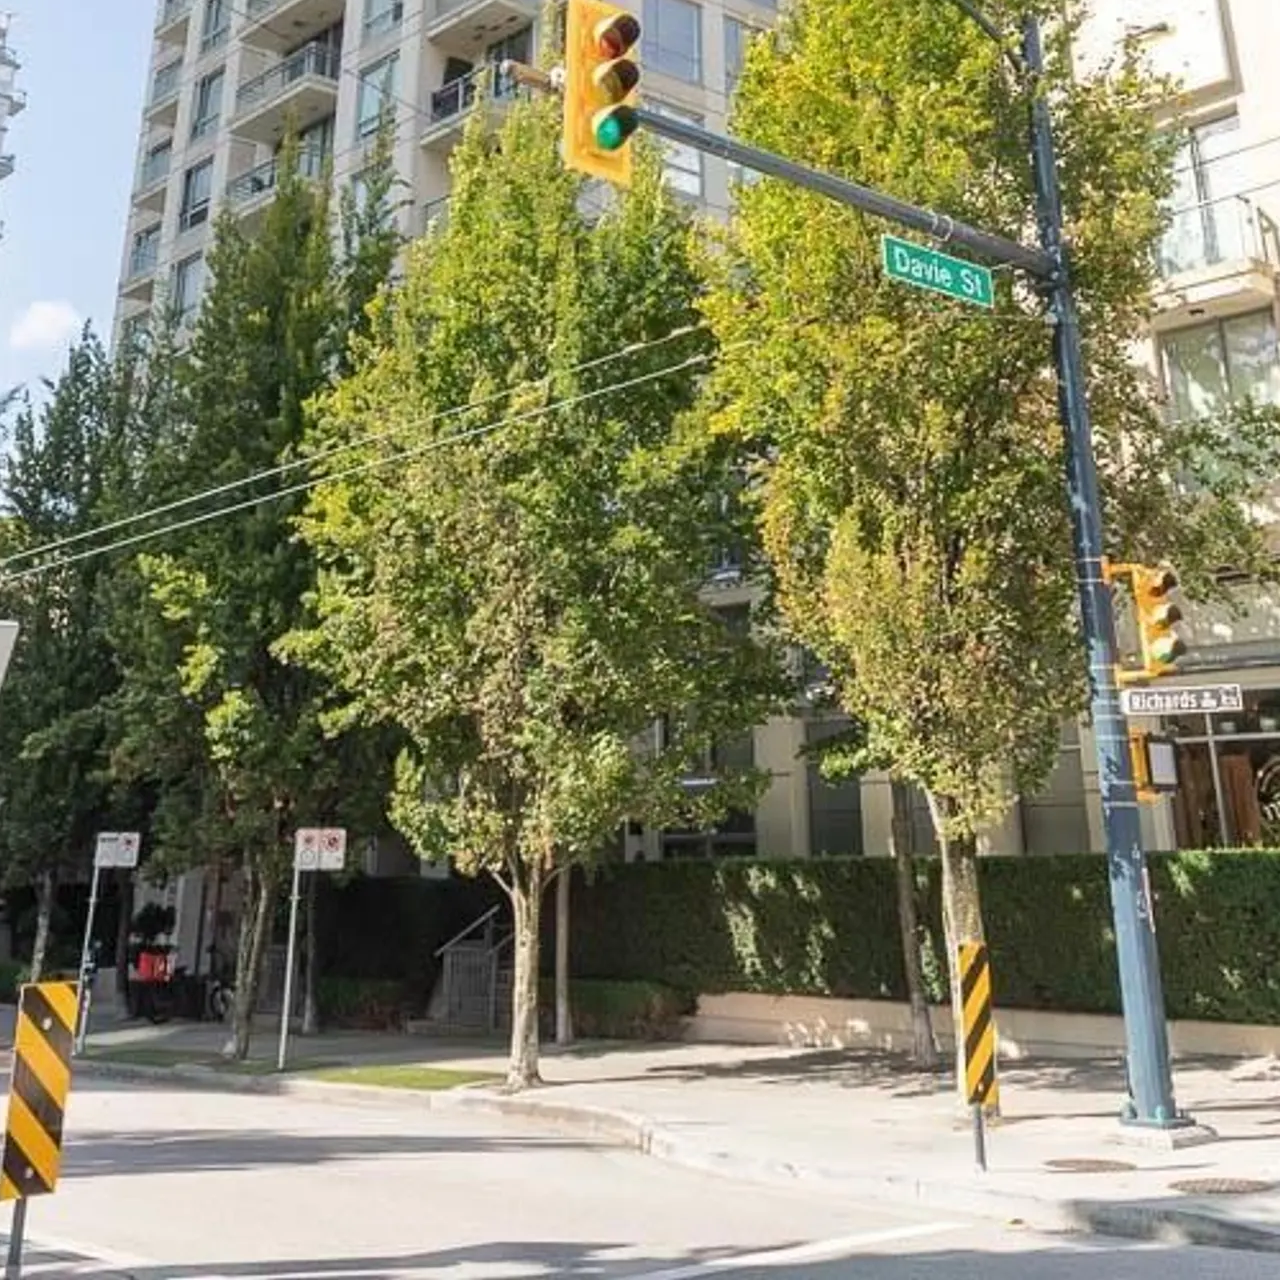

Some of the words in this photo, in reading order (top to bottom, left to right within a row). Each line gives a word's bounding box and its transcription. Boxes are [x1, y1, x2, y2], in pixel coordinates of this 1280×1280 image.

[893, 245, 953, 288] Davie
[960, 268, 983, 298] St
[1131, 690, 1198, 710] Richards
